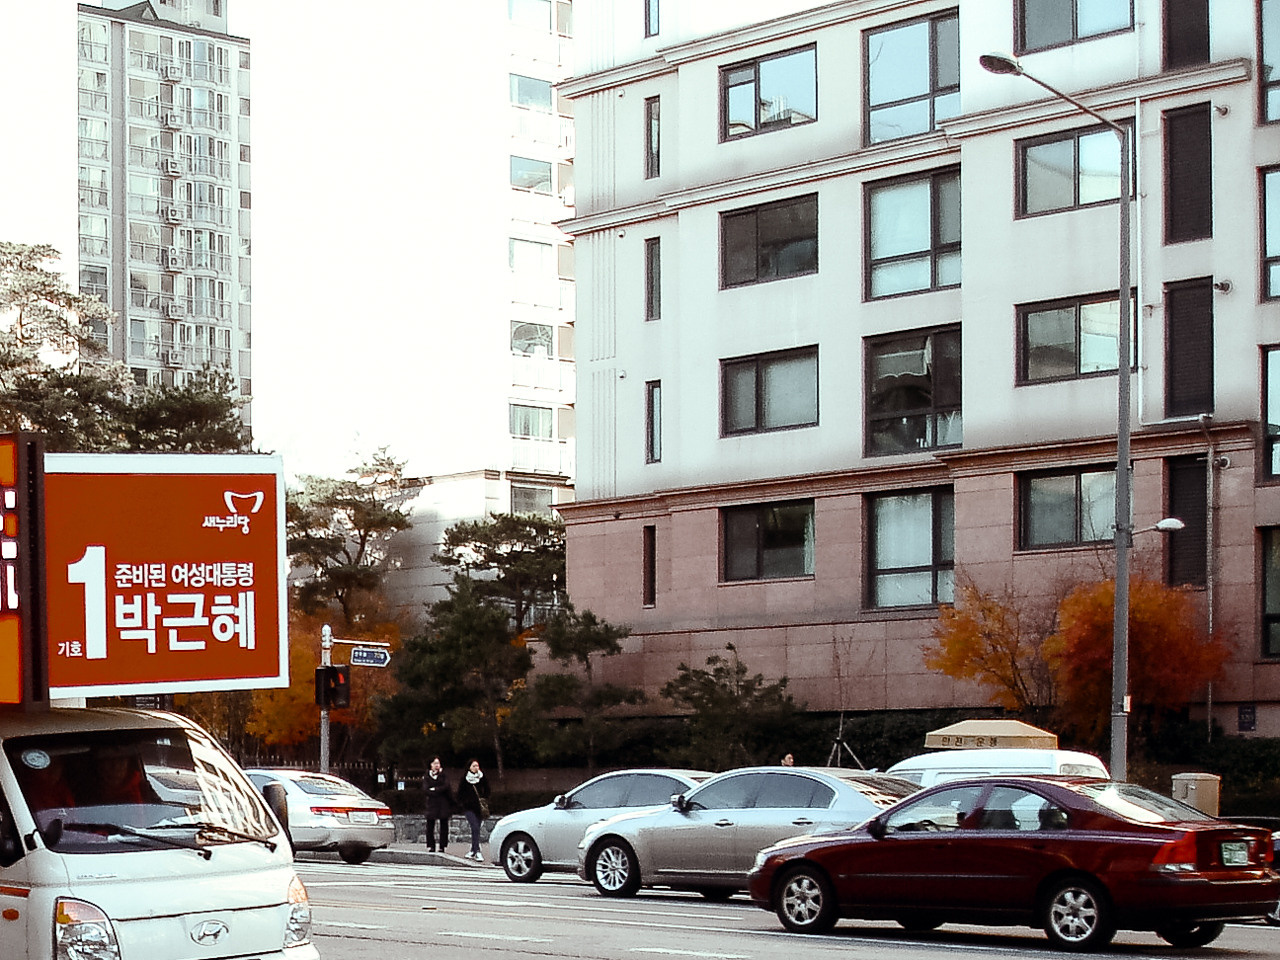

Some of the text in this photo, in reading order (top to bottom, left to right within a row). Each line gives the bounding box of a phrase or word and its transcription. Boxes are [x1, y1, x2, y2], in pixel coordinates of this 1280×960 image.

[202, 514, 250, 534] 새누리당
[114, 562, 254, 588] 준비된 여성대통령
[67, 545, 107, 659] 1
[115, 590, 256, 653] 박근혜
[57, 641, 83, 657] 기호
